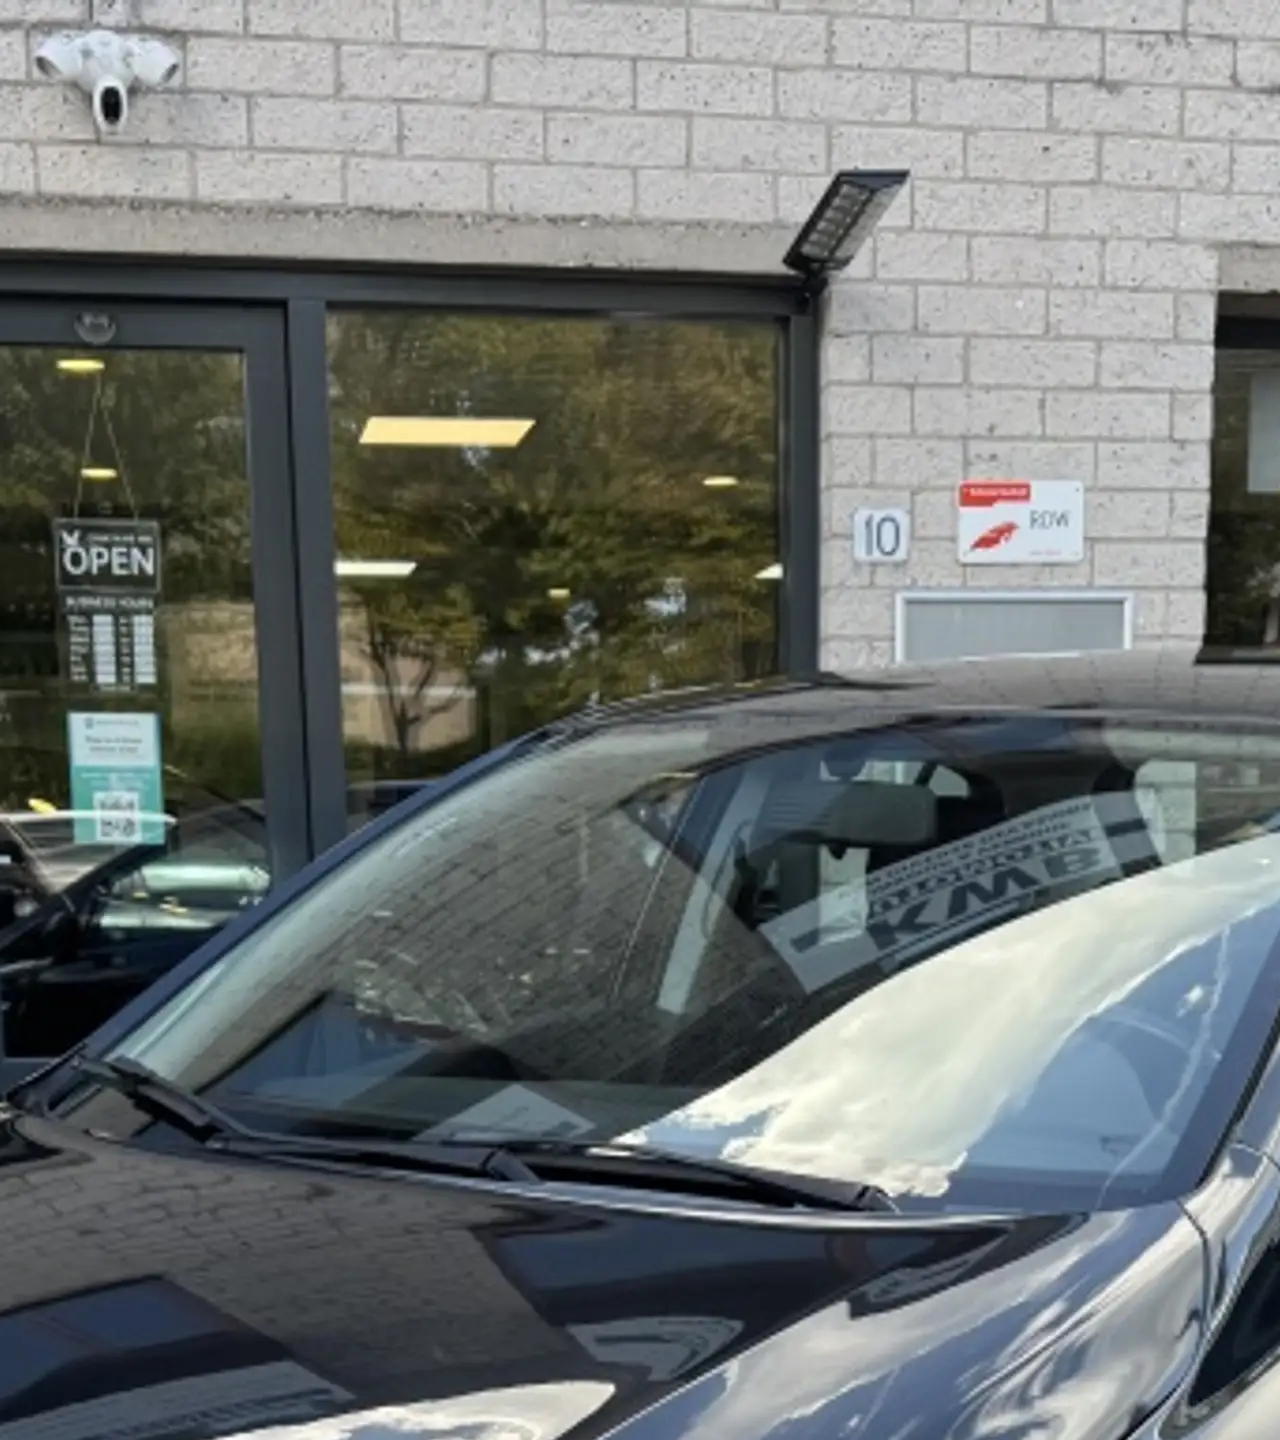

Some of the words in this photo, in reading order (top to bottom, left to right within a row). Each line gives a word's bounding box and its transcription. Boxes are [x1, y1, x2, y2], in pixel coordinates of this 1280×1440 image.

[864, 512, 901, 558] 10
[1028, 509, 1070, 531] RDW
[63, 545, 155, 577] OPEN
